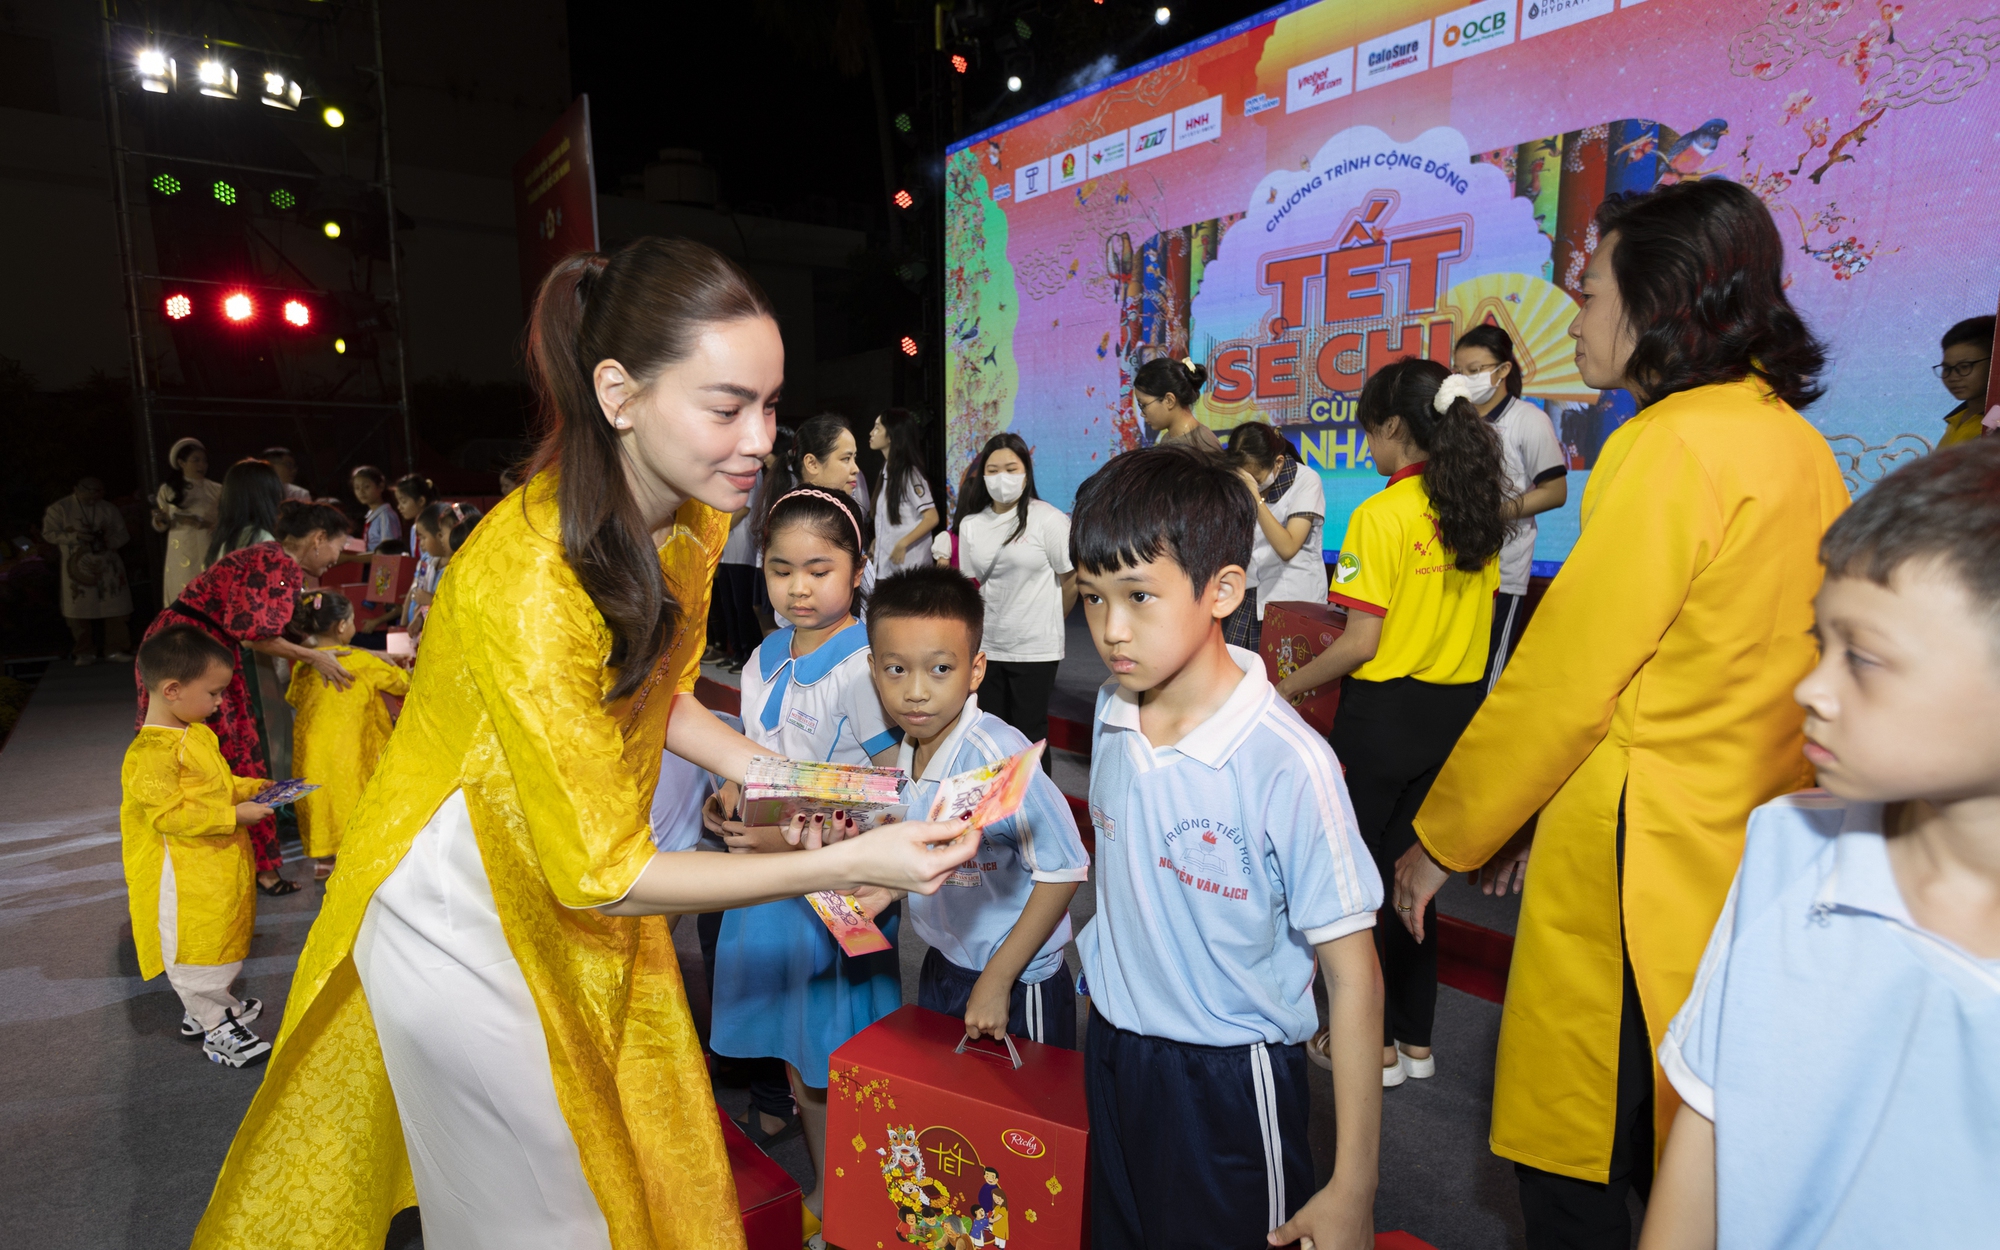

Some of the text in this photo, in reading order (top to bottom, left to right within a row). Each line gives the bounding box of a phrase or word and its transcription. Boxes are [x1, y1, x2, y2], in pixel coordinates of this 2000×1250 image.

[1463, 11, 1506, 39] OCB
[1368, 40, 1419, 66] CaloSure
[1186, 113, 1209, 130] HNH
[1135, 128, 1167, 153] HTV
[1266, 150, 1468, 233] CHƯƠNG TRÌNH CỘNG ĐỒNG
[1264, 199, 1463, 329] TẾT
[1211, 311, 1523, 403] SẺ CHI
[1311, 395, 1358, 423] CÙ
[1301, 428, 1376, 470] NHẠ
[1164, 818, 1251, 875] TRƯỜNG TIỂU HỌC
[1196, 878, 1221, 894] VĂN
[1222, 886, 1249, 901] LỊCH
[211, 1030, 222, 1039] FILA
[1010, 1132, 1037, 1155] Richy
